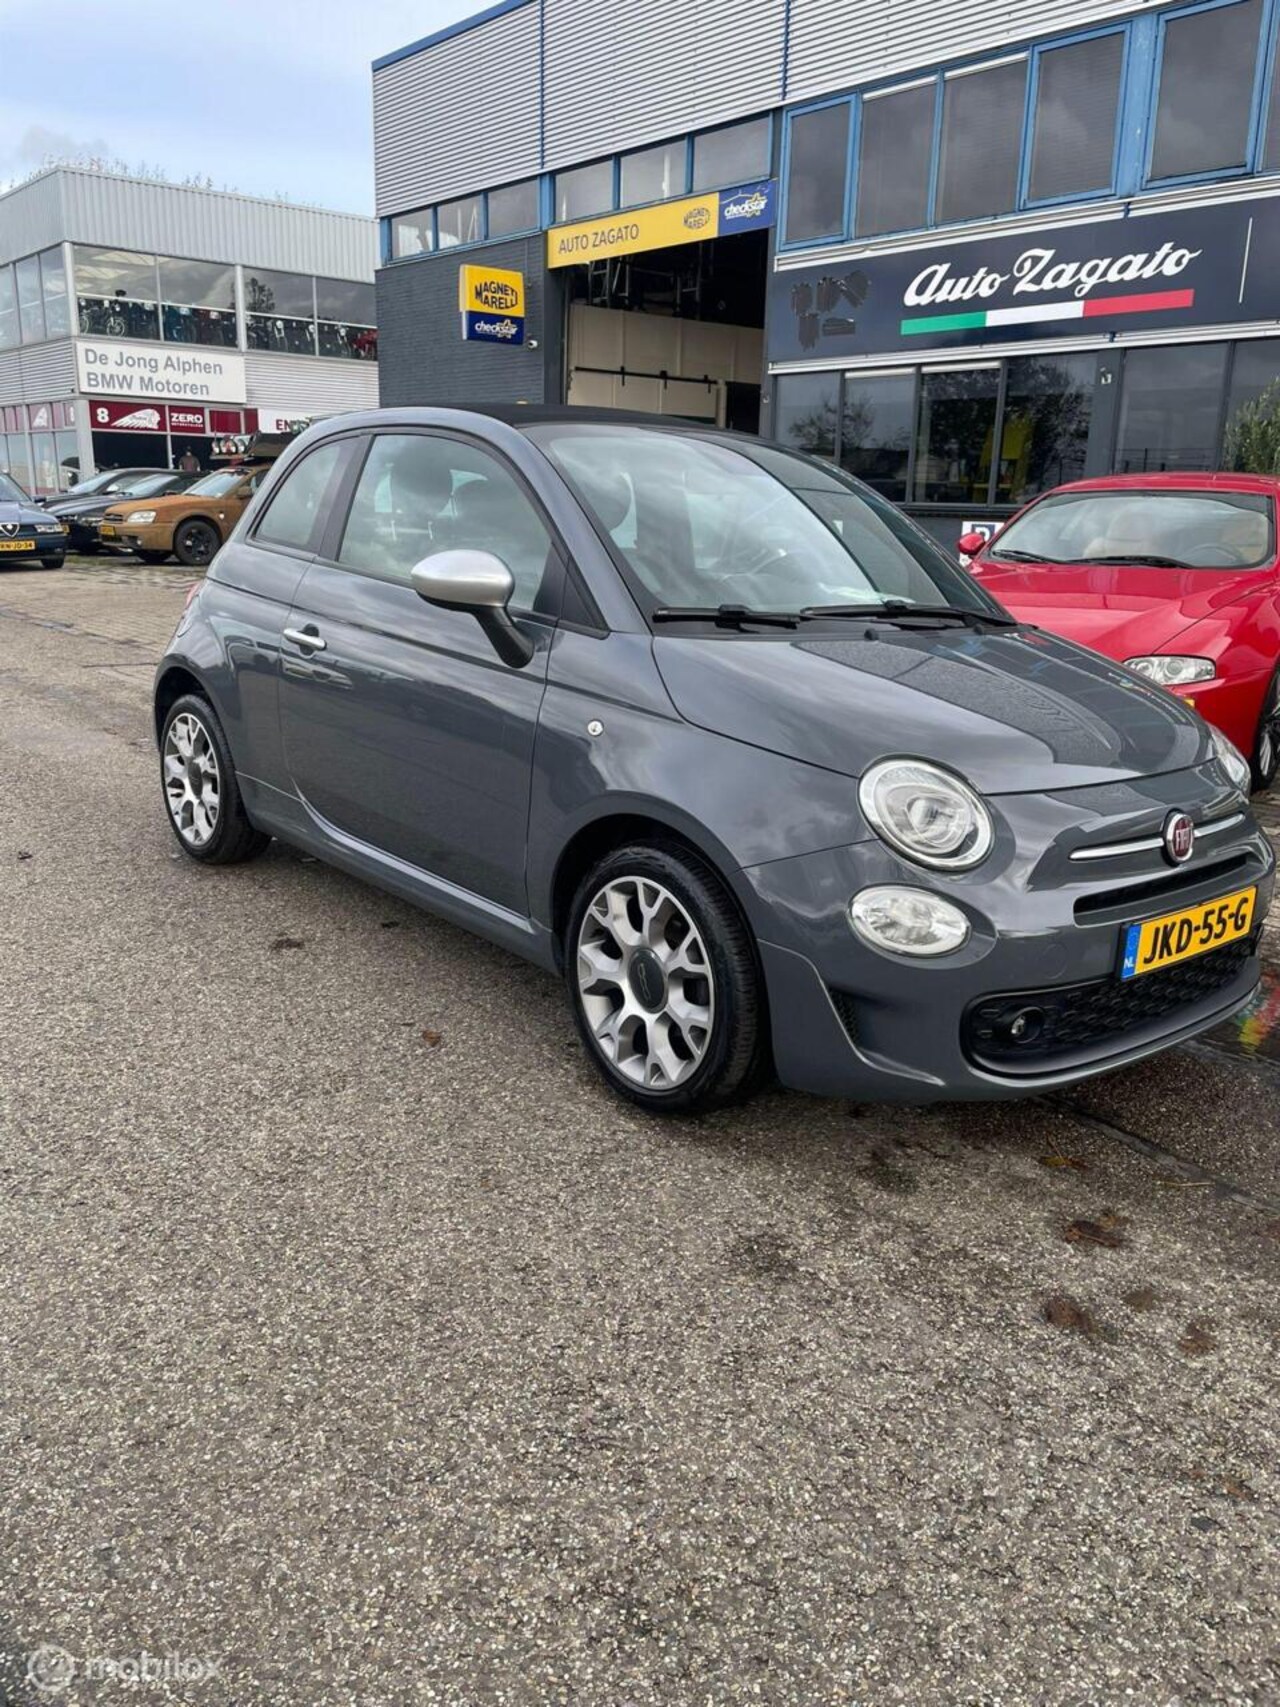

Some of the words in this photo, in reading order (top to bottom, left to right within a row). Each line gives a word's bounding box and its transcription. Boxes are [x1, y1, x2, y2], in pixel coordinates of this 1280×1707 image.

[559, 234, 589, 254] AUTO
[592, 224, 640, 247] ZAGATO
[904, 262, 1011, 307] Auto
[1012, 242, 1203, 298] Zagato
[85, 349, 108, 365] De
[114, 352, 158, 373] Jong
[163, 356, 223, 376] Alphen
[87, 372, 133, 390] BMW
[140, 376, 210, 396] Motoren
[96, 407, 110, 423] 8
[170, 412, 204, 424] ZERO
[1143, 897, 1249, 964] JKD-55-G
[1124, 957, 1134, 969] NL
